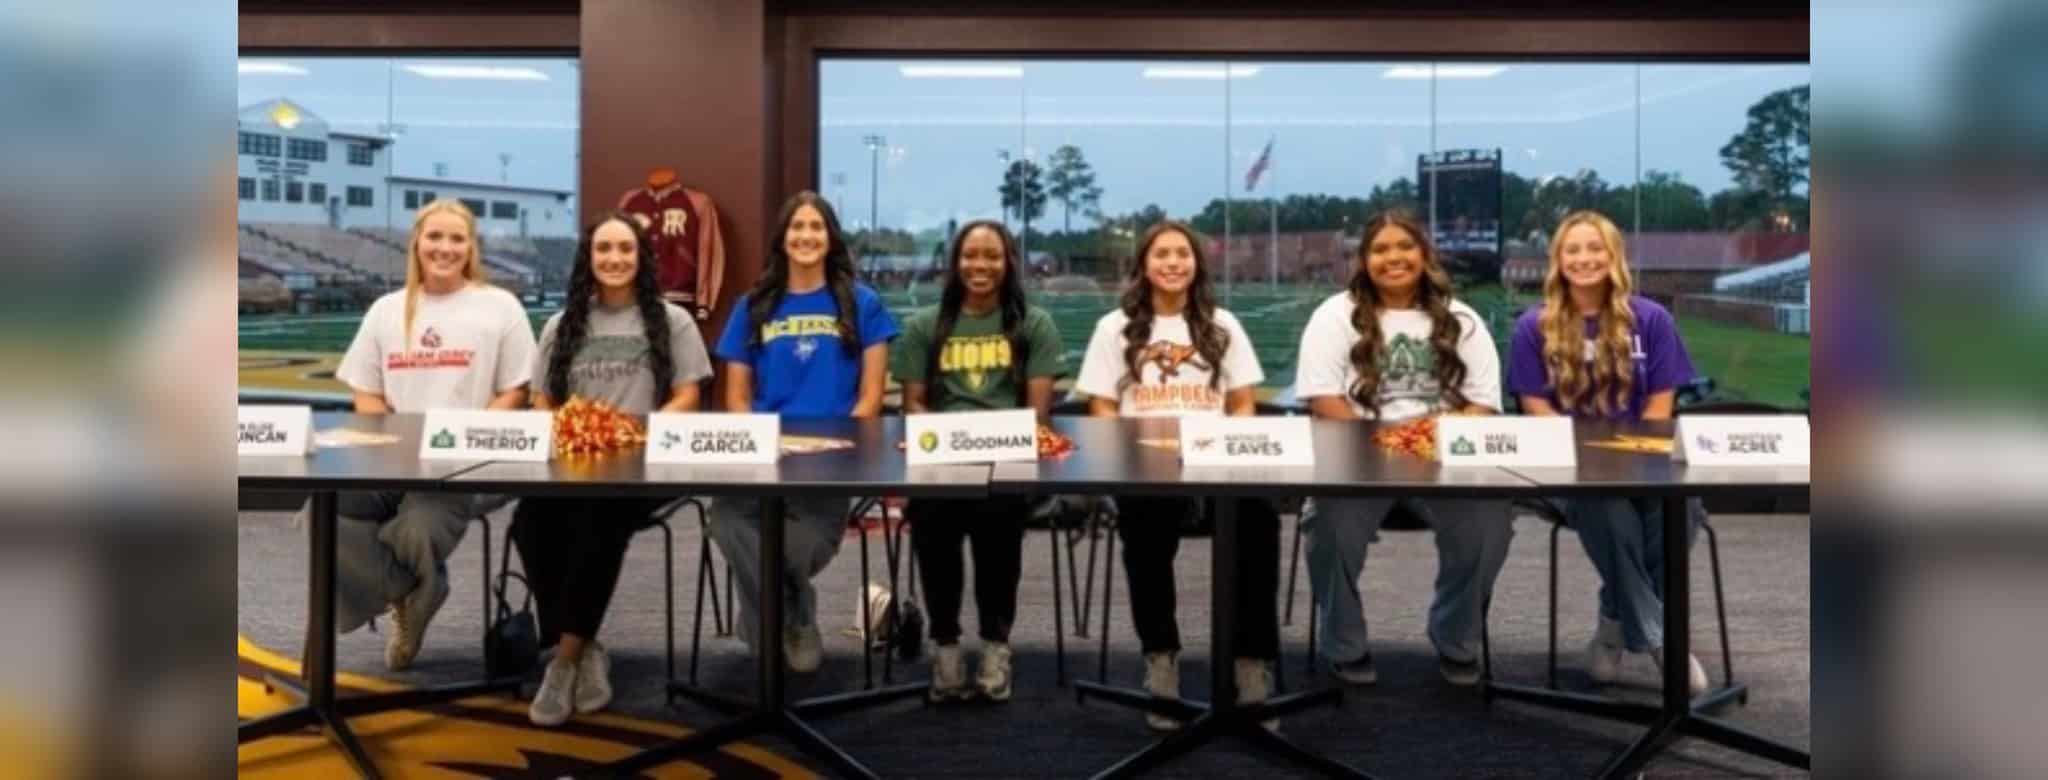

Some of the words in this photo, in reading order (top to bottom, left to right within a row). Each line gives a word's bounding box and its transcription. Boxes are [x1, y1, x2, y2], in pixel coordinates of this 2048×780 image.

[940, 340, 1011, 371] LIONS
[464, 436, 540, 450] THERIOT
[690, 439, 758, 453] GARCIA
[950, 435, 1033, 451] GOODMAN
[1226, 441, 1284, 455] EAVES
[1485, 441, 1519, 454] BEN
[1728, 441, 1780, 454] ACREE
